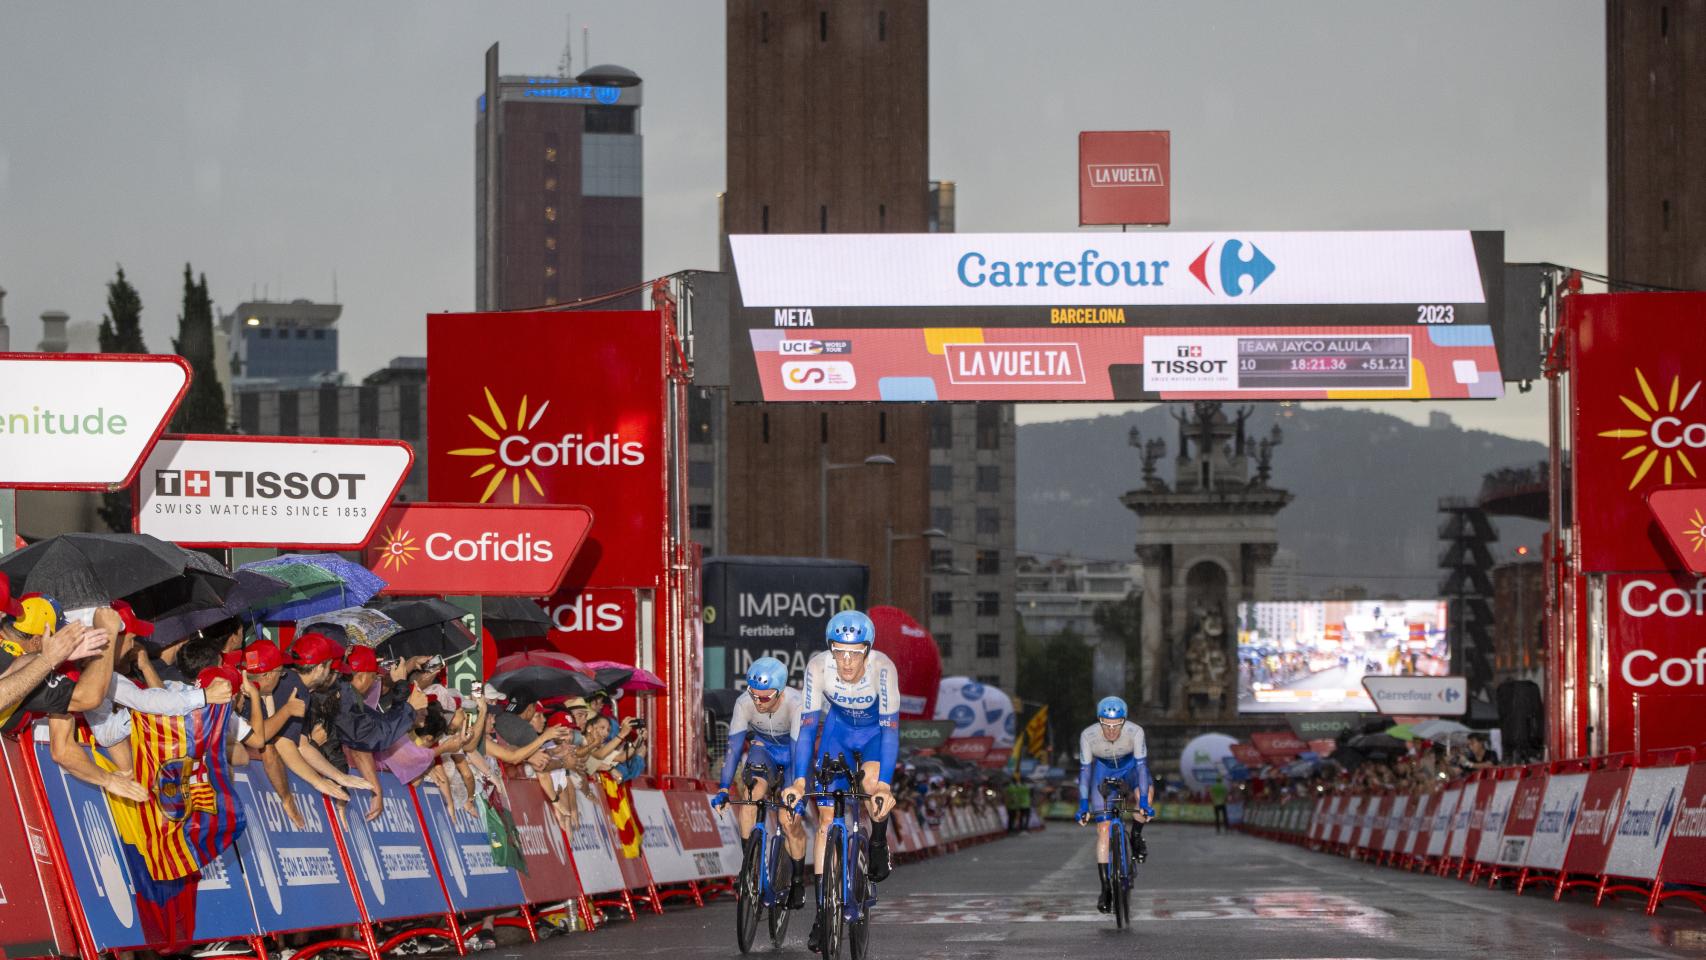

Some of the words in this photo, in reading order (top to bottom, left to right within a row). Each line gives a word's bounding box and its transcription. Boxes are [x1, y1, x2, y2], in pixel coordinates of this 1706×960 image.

[1095, 168, 1111, 182] LA
[1112, 168, 1156, 182] VUELTA
[957, 250, 1170, 287] Carrefour
[775, 308, 814, 327] META
[1051, 308, 1126, 325] BARCELONA
[1417, 305, 1454, 324] 2023
[783, 342, 806, 352] UCI
[1239, 341, 1279, 352] TEAM
[1281, 340, 1325, 352] JAYCO
[1327, 340, 1373, 352] ALULA
[959, 351, 986, 376] LA
[989, 351, 1072, 376] VUELTA
[1152, 360, 1228, 374] TISSOT
[1240, 359, 1257, 370] 10
[1291, 358, 1347, 370] 18:21.36
[1361, 358, 1406, 370] +51.21
[499, 433, 645, 467] Cofidis
[215, 471, 366, 500] TISSOT
[155, 503, 202, 515] SWISS
[210, 505, 278, 516] WATCHES
[286, 506, 329, 517] SINCE
[337, 507, 367, 517] 1853
[425, 532, 554, 562] Cofidis
[739, 624, 796, 637] Fertiberia
[831, 692, 874, 705] Jayco
[1377, 689, 1432, 700] Carrefour
[283, 857, 299, 877] CON
